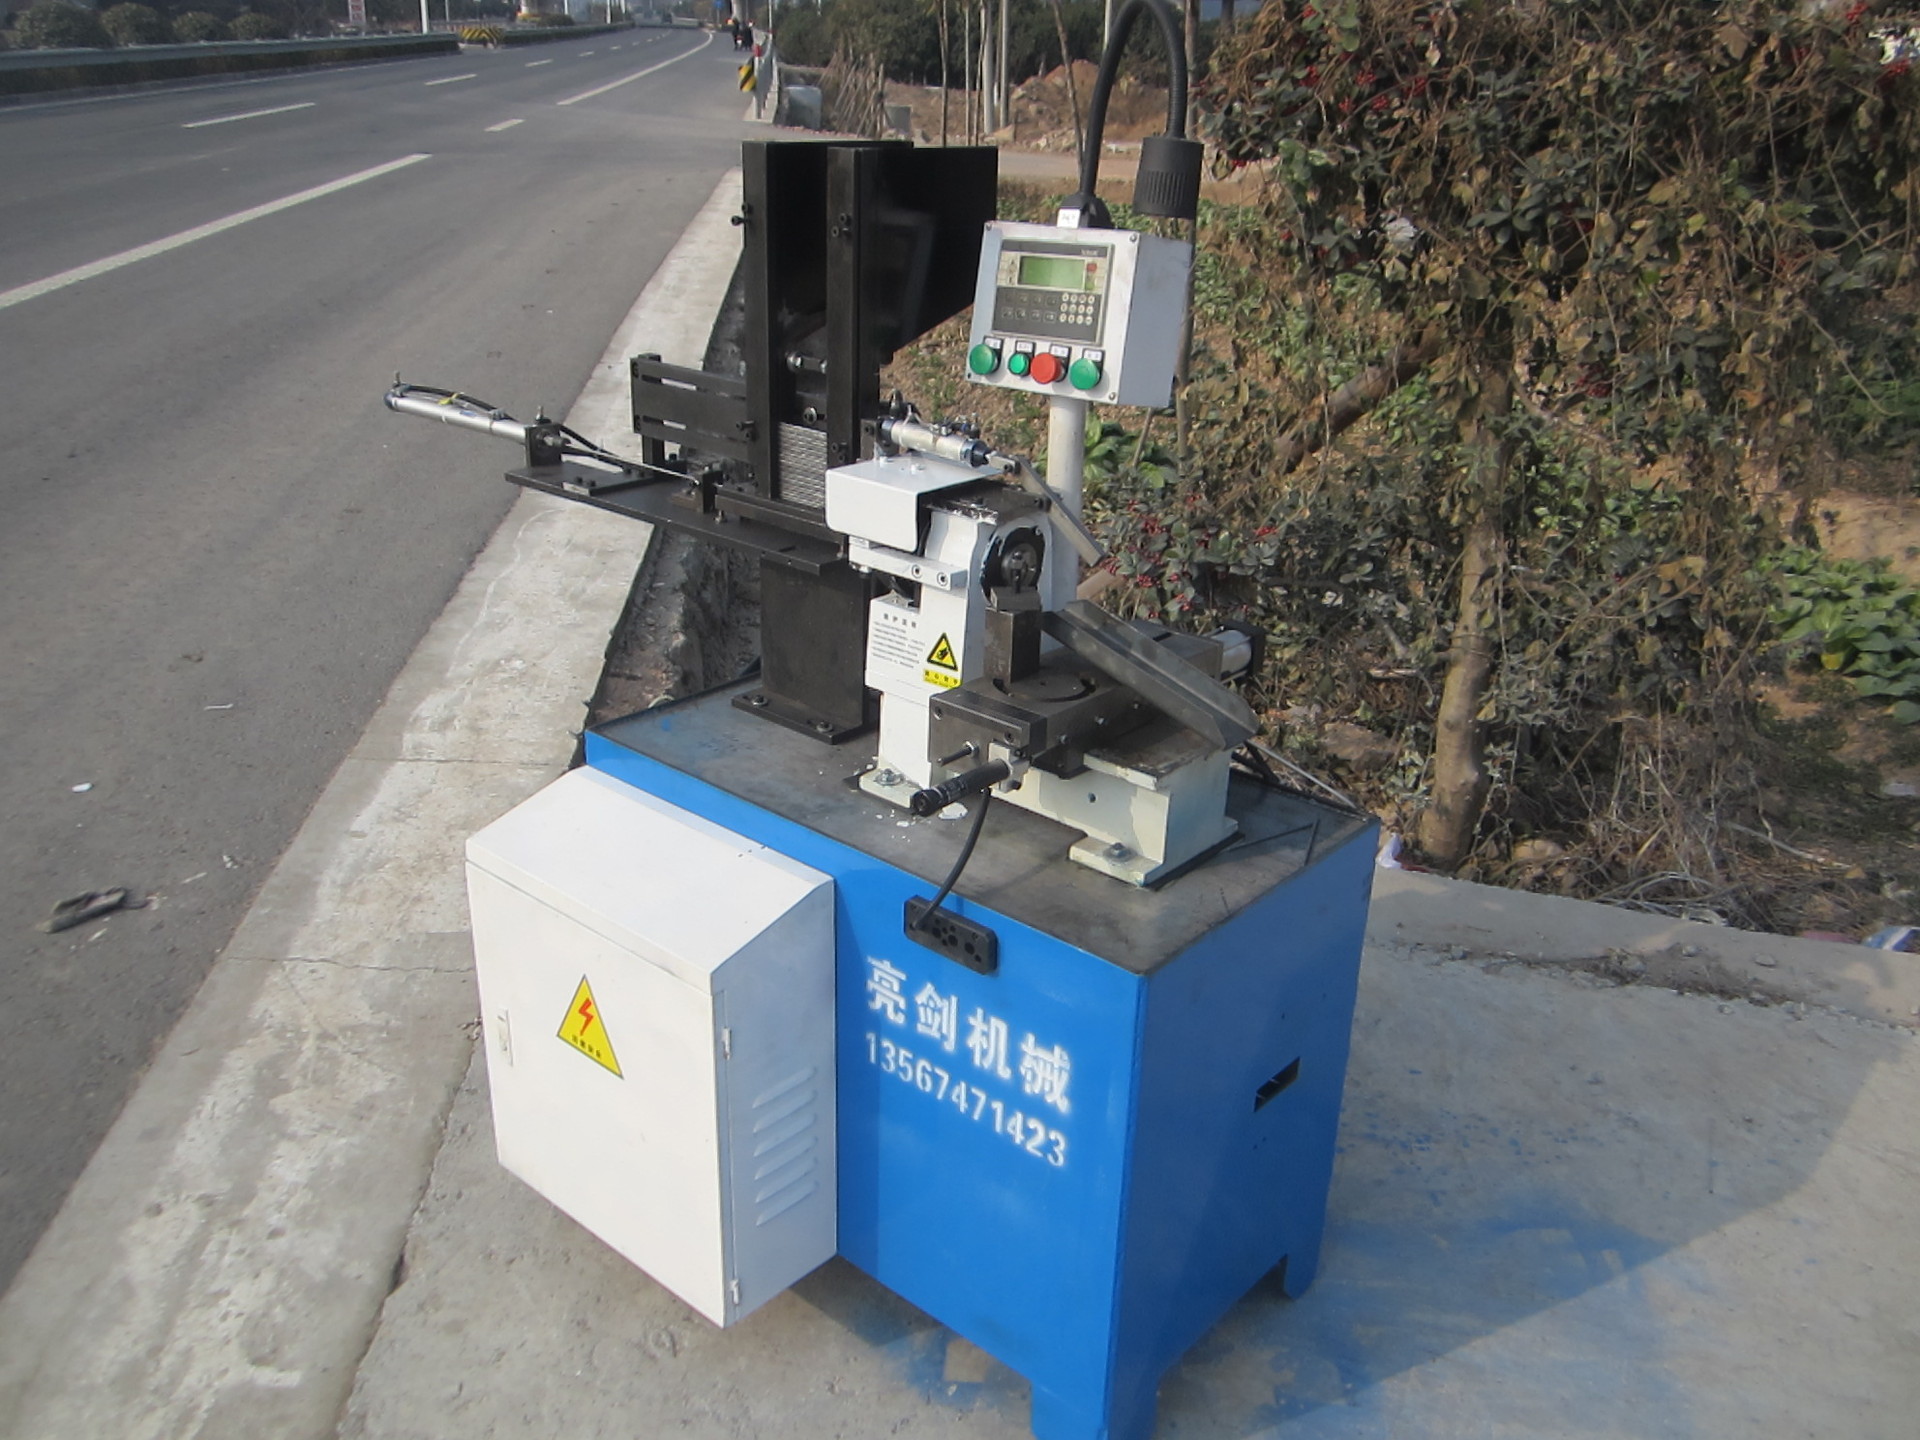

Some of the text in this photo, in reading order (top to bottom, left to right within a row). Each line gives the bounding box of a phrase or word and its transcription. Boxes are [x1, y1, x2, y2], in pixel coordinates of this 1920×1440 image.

[866, 956, 1071, 1113] 亮剑机械
[866, 1032, 1066, 1168] 13567471423
